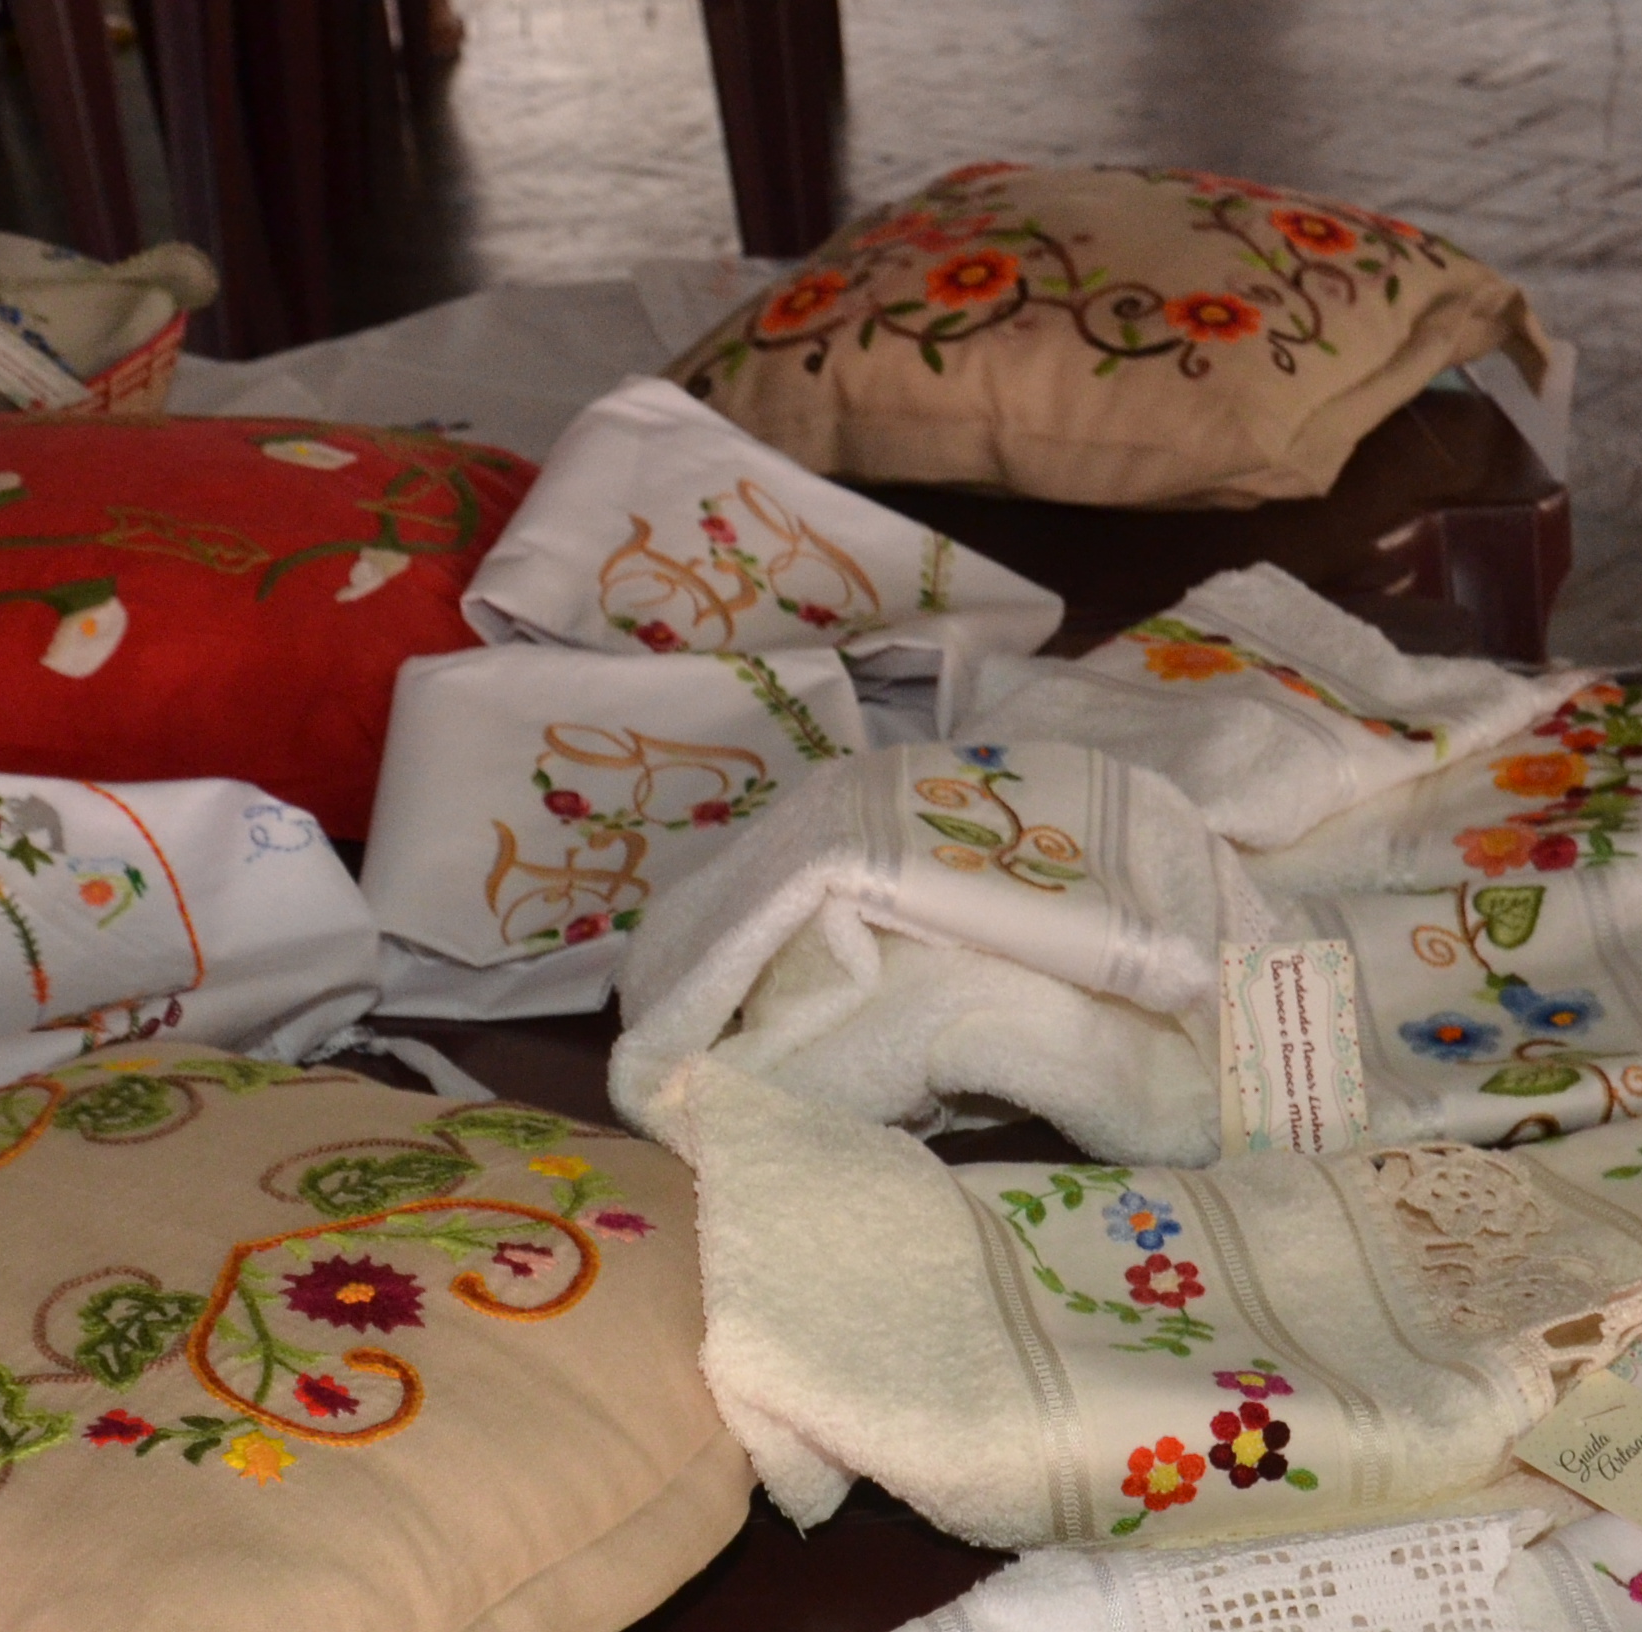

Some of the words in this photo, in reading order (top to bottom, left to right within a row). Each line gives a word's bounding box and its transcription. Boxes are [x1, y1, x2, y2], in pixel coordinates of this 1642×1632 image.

[1291, 955, 1312, 1036] Bordando
[1270, 960, 1286, 1026] Barroco
[1281, 1043, 1295, 1098] Rococo
[1302, 1041, 1316, 1091] Novas
[1308, 1096, 1324, 1154] Linhas
[1556, 1432, 1611, 1483] Guida
